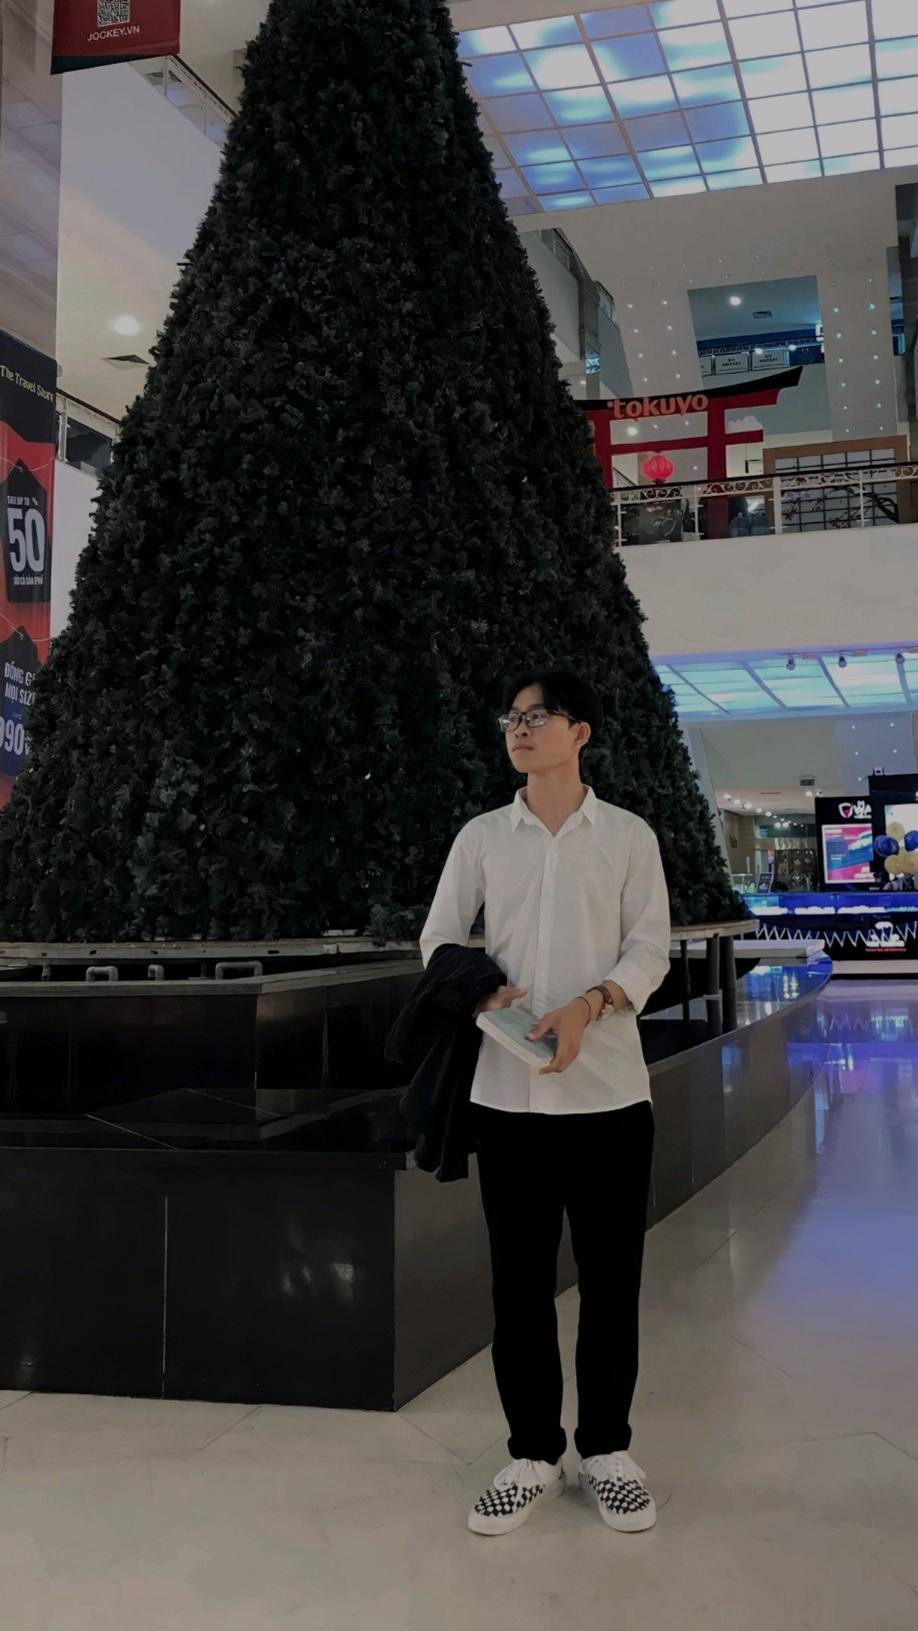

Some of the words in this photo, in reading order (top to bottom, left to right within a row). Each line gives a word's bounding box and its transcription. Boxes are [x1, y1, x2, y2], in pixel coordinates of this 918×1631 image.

[87, 25, 140, 41] JOCKEY.VN
[0, 364, 15, 381] The
[15, 372, 36, 393] Travel
[612, 393, 709, 419] tokuyo
[7, 508, 45, 572] 50
